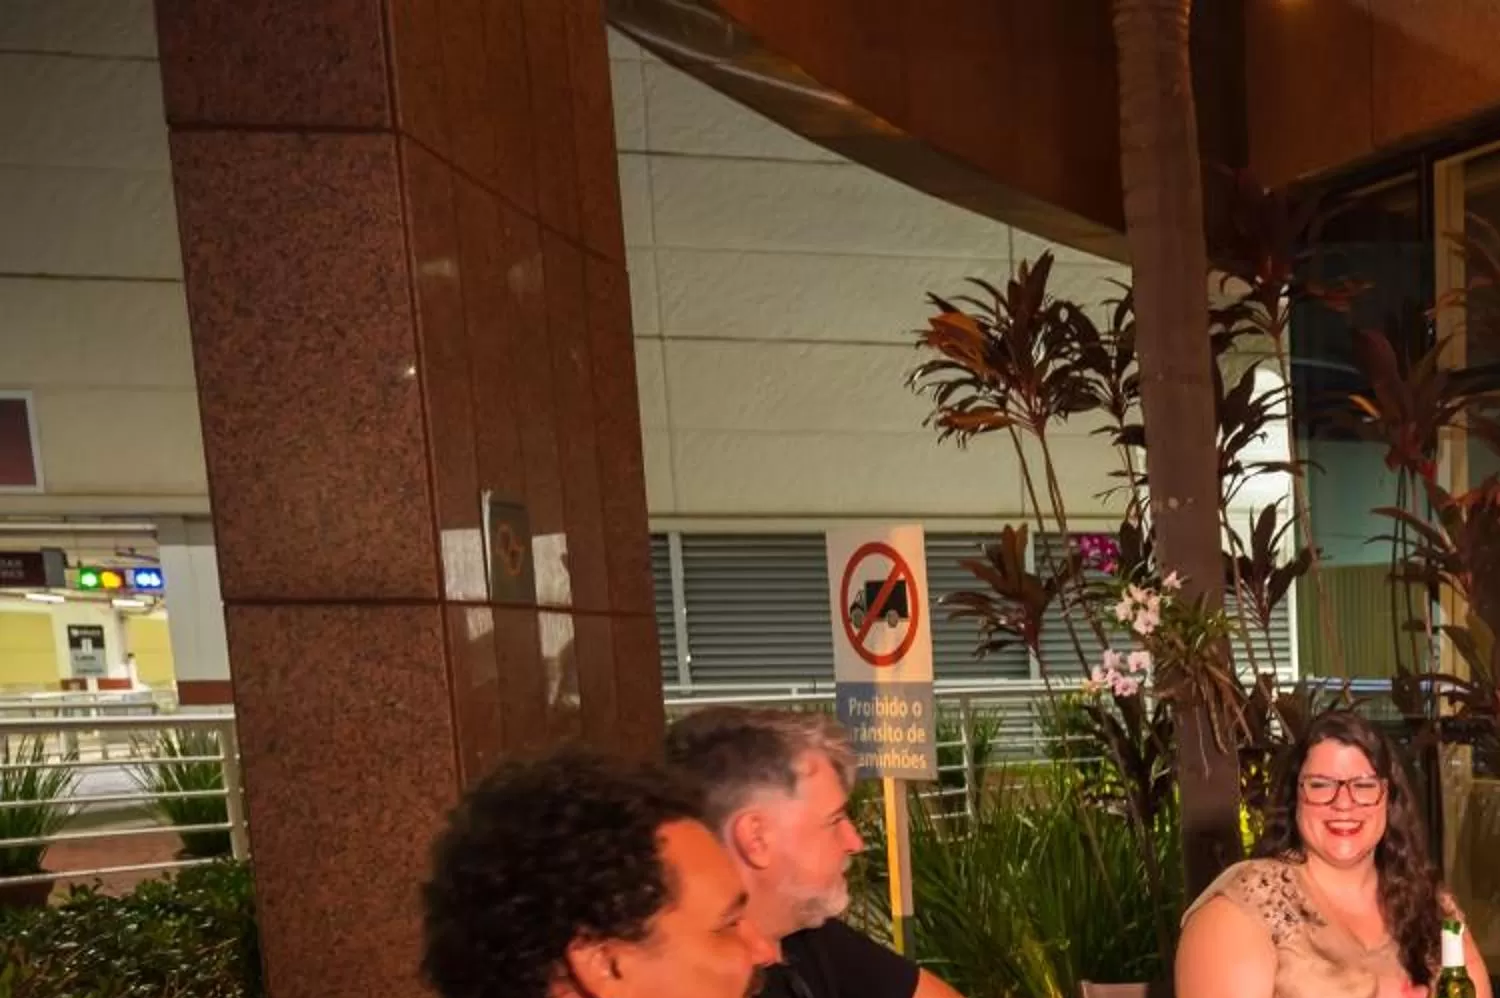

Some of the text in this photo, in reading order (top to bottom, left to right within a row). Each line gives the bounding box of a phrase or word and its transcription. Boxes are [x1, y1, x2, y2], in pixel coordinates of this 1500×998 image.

[848, 695, 923, 717] Proibido o
[852, 720, 926, 743] rânsito de
[856, 748, 927, 769] aminhões
